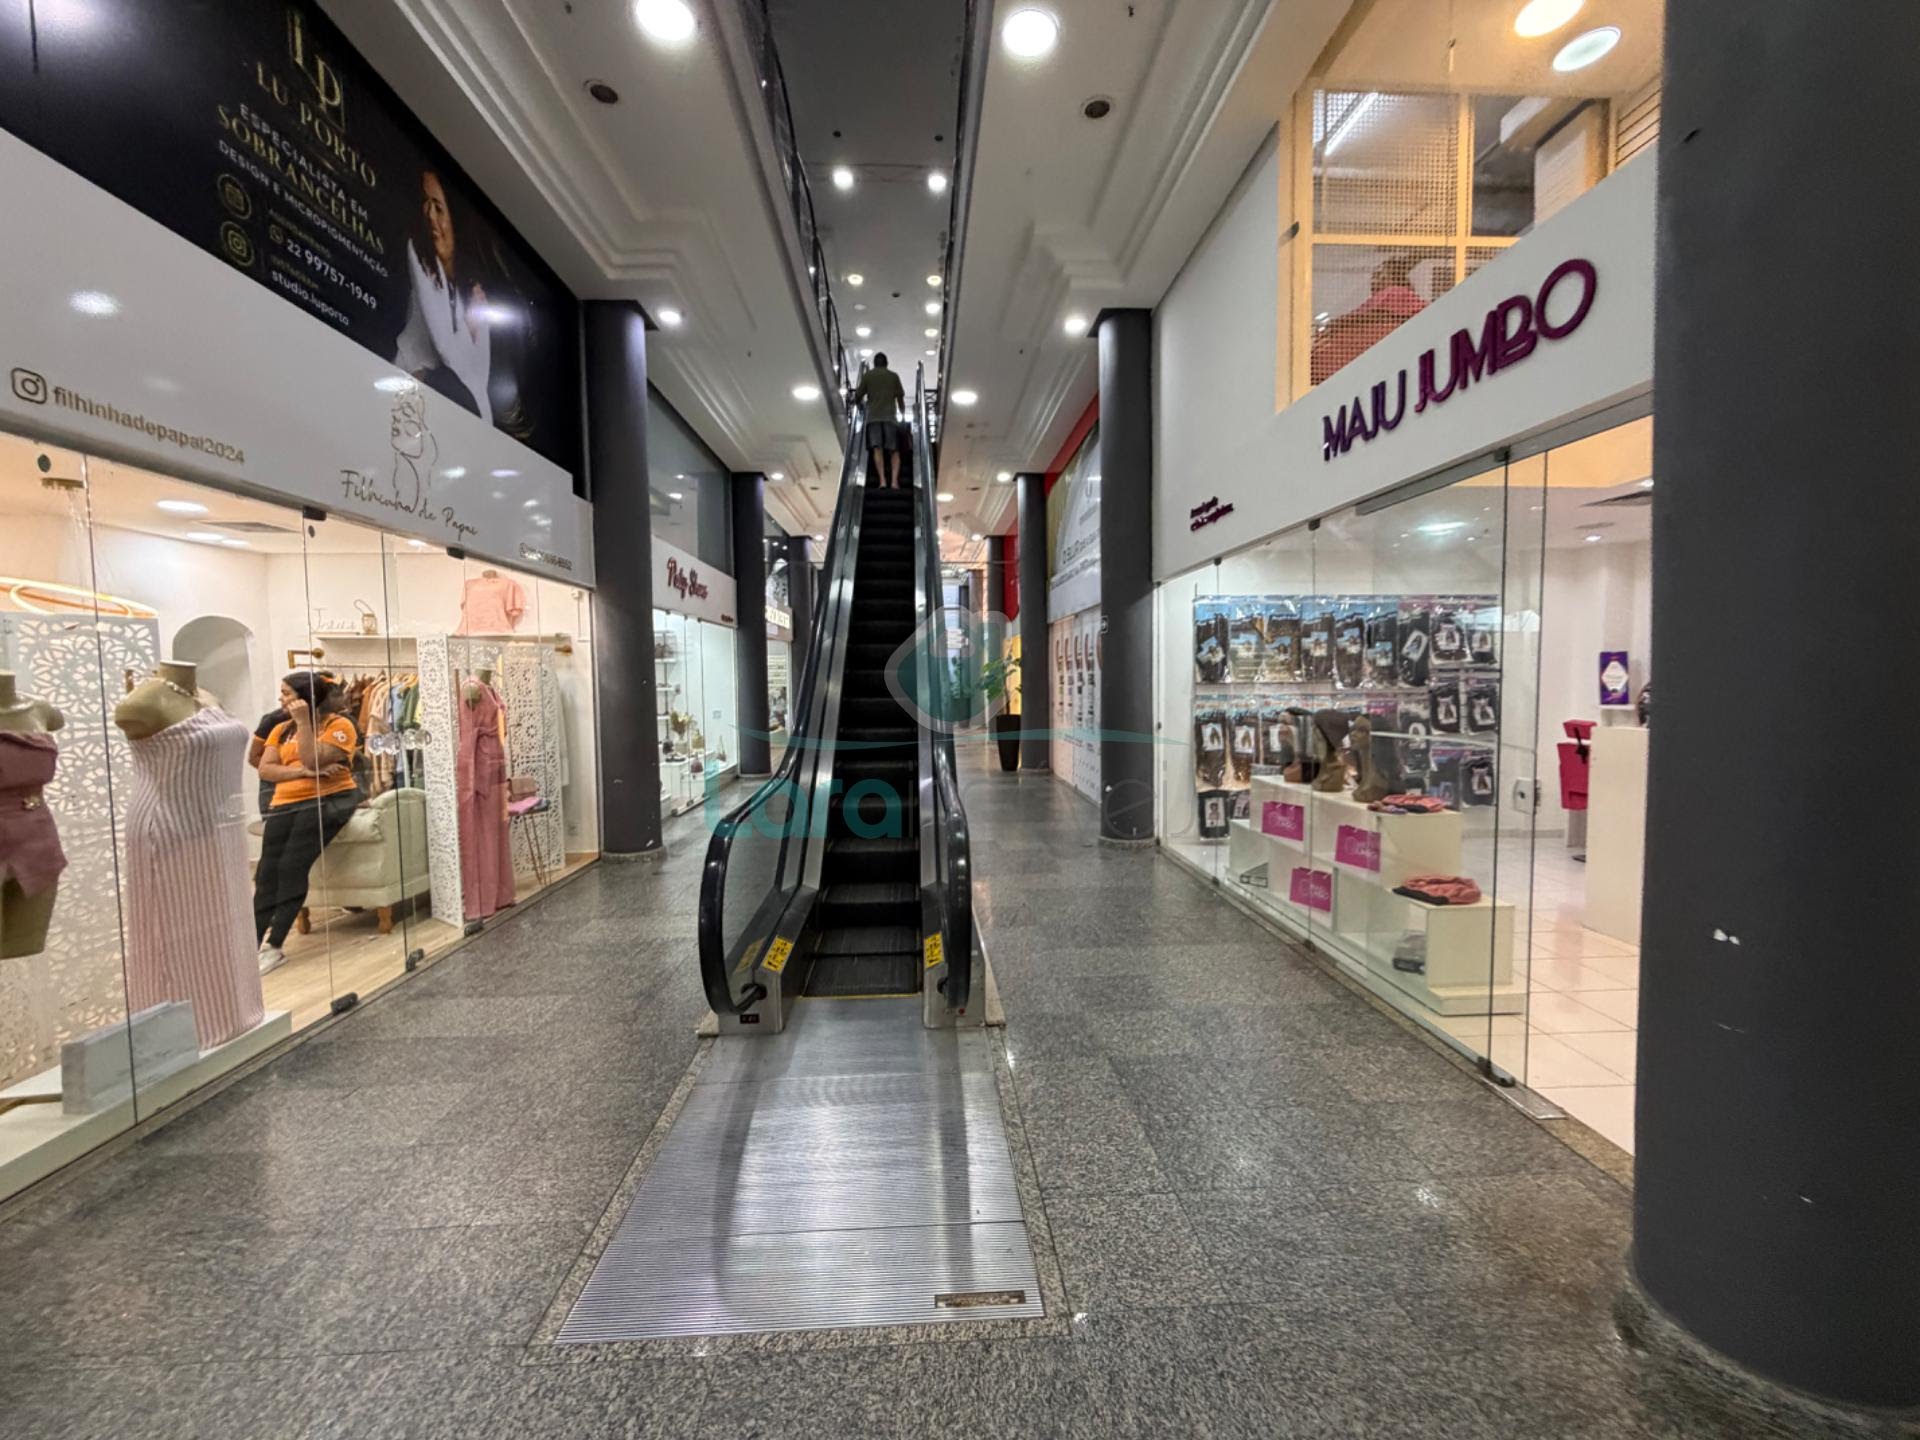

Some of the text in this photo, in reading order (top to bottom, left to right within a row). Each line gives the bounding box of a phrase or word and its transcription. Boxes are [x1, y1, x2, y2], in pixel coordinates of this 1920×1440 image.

[217, 104, 385, 254] SOBRANCELHAS
[239, 103, 368, 220] ESPECIALISTA EM
[300, 102, 376, 188] PORTO
[218, 139, 269, 187] DESIGN
[273, 179, 281, 196] E
[284, 190, 389, 277] MICROPIGMENTAÇÃO
[287, 238, 302, 258] 22
[304, 248, 377, 310] 99757-1949
[1322, 258, 1598, 462] MAJU JUMBO
[54, 386, 246, 464] filhinhadepapai2024
[340, 469, 479, 541] Filhinha de Papai
